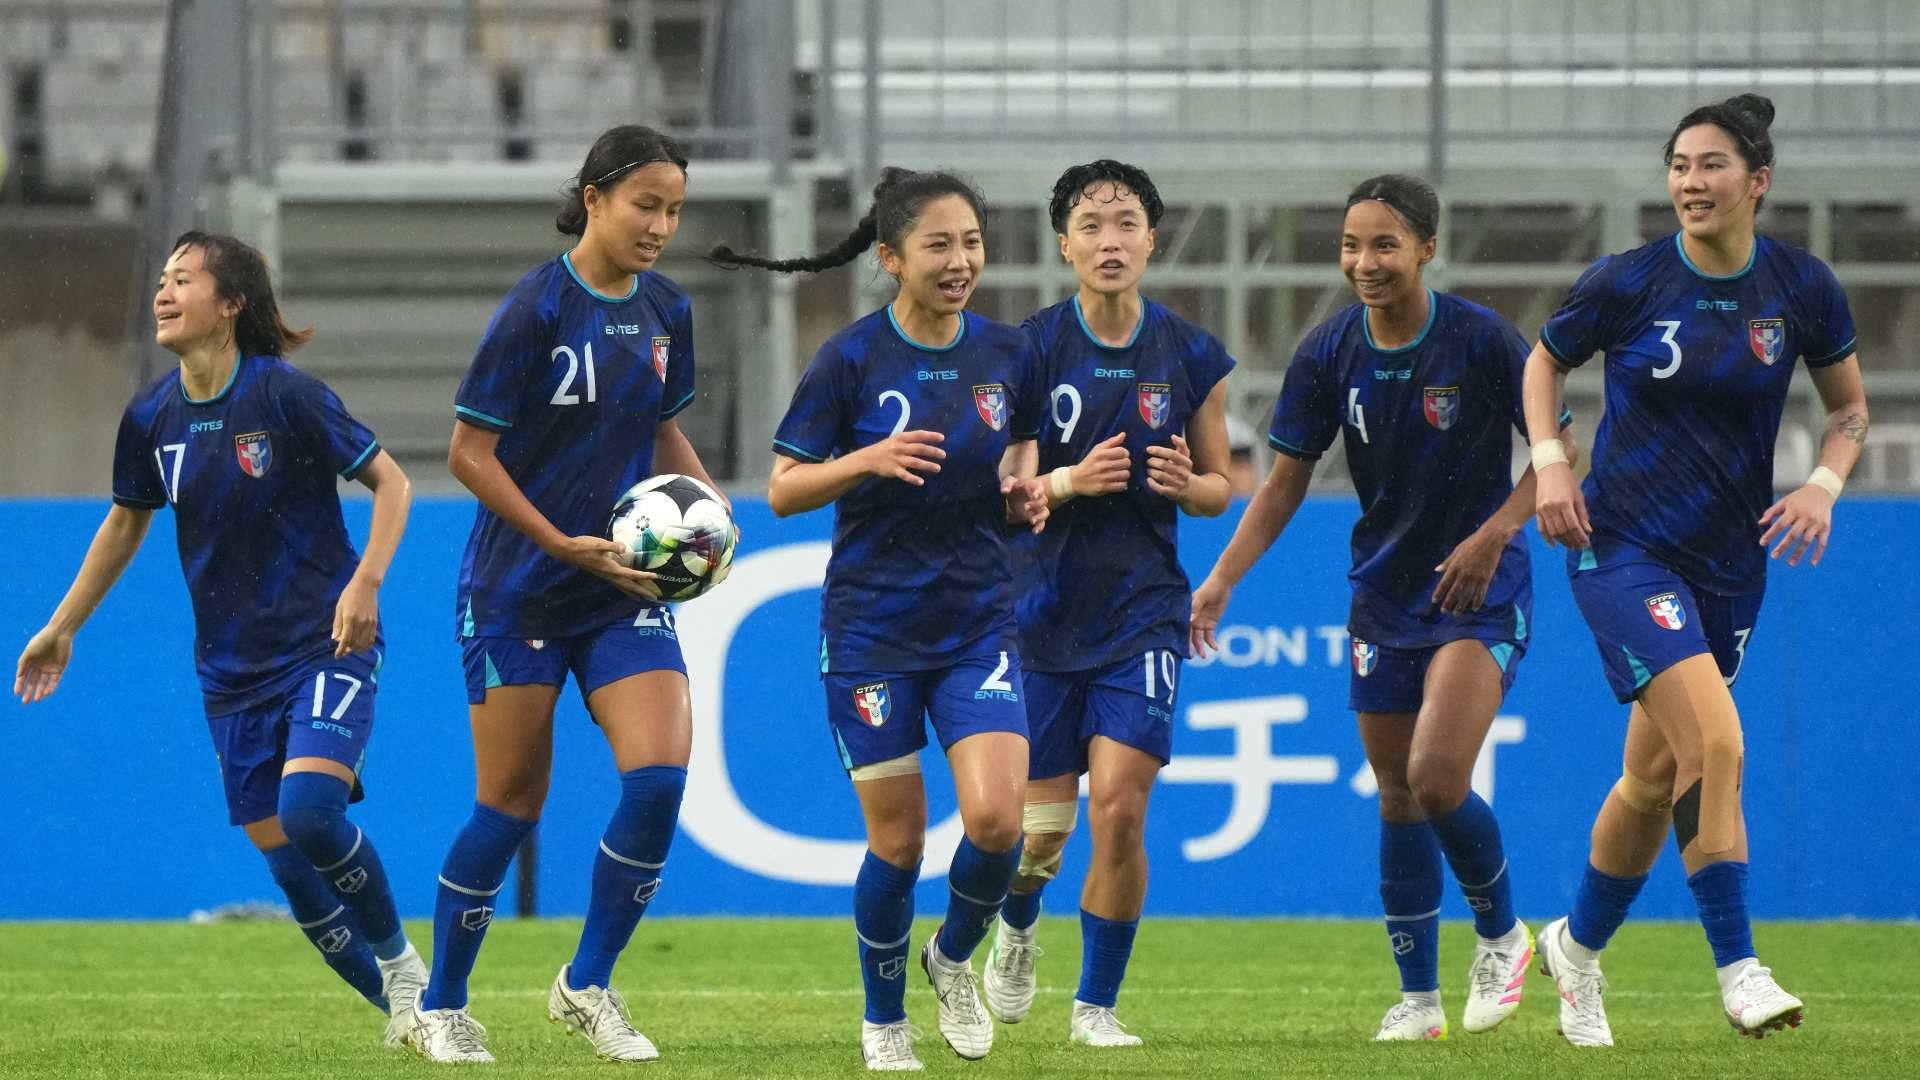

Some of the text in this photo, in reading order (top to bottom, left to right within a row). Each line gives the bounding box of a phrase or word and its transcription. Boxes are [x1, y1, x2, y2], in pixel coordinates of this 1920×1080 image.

[1695, 300, 1738, 311] ENTES
[605, 324, 639, 335] ENTES
[1652, 320, 1682, 379] 3
[550, 341, 596, 406] 21
[917, 370, 959, 381] ENTES
[1094, 368, 1136, 379] ENTES
[1374, 369, 1413, 381] ENTES
[878, 389, 911, 438] 2
[1347, 388, 1369, 444] 4
[189, 420, 224, 433] ENTES
[238, 434, 266, 444] CTFA
[154, 443, 186, 504] 17
[1724, 627, 1752, 687] 3
[979, 651, 1012, 692] 2
[1144, 650, 1175, 705] 19
[311, 671, 362, 720] 17
[856, 683, 884, 694] CTFA
[974, 690, 1018, 703] ENTES
[311, 721, 353, 738] ENTES
